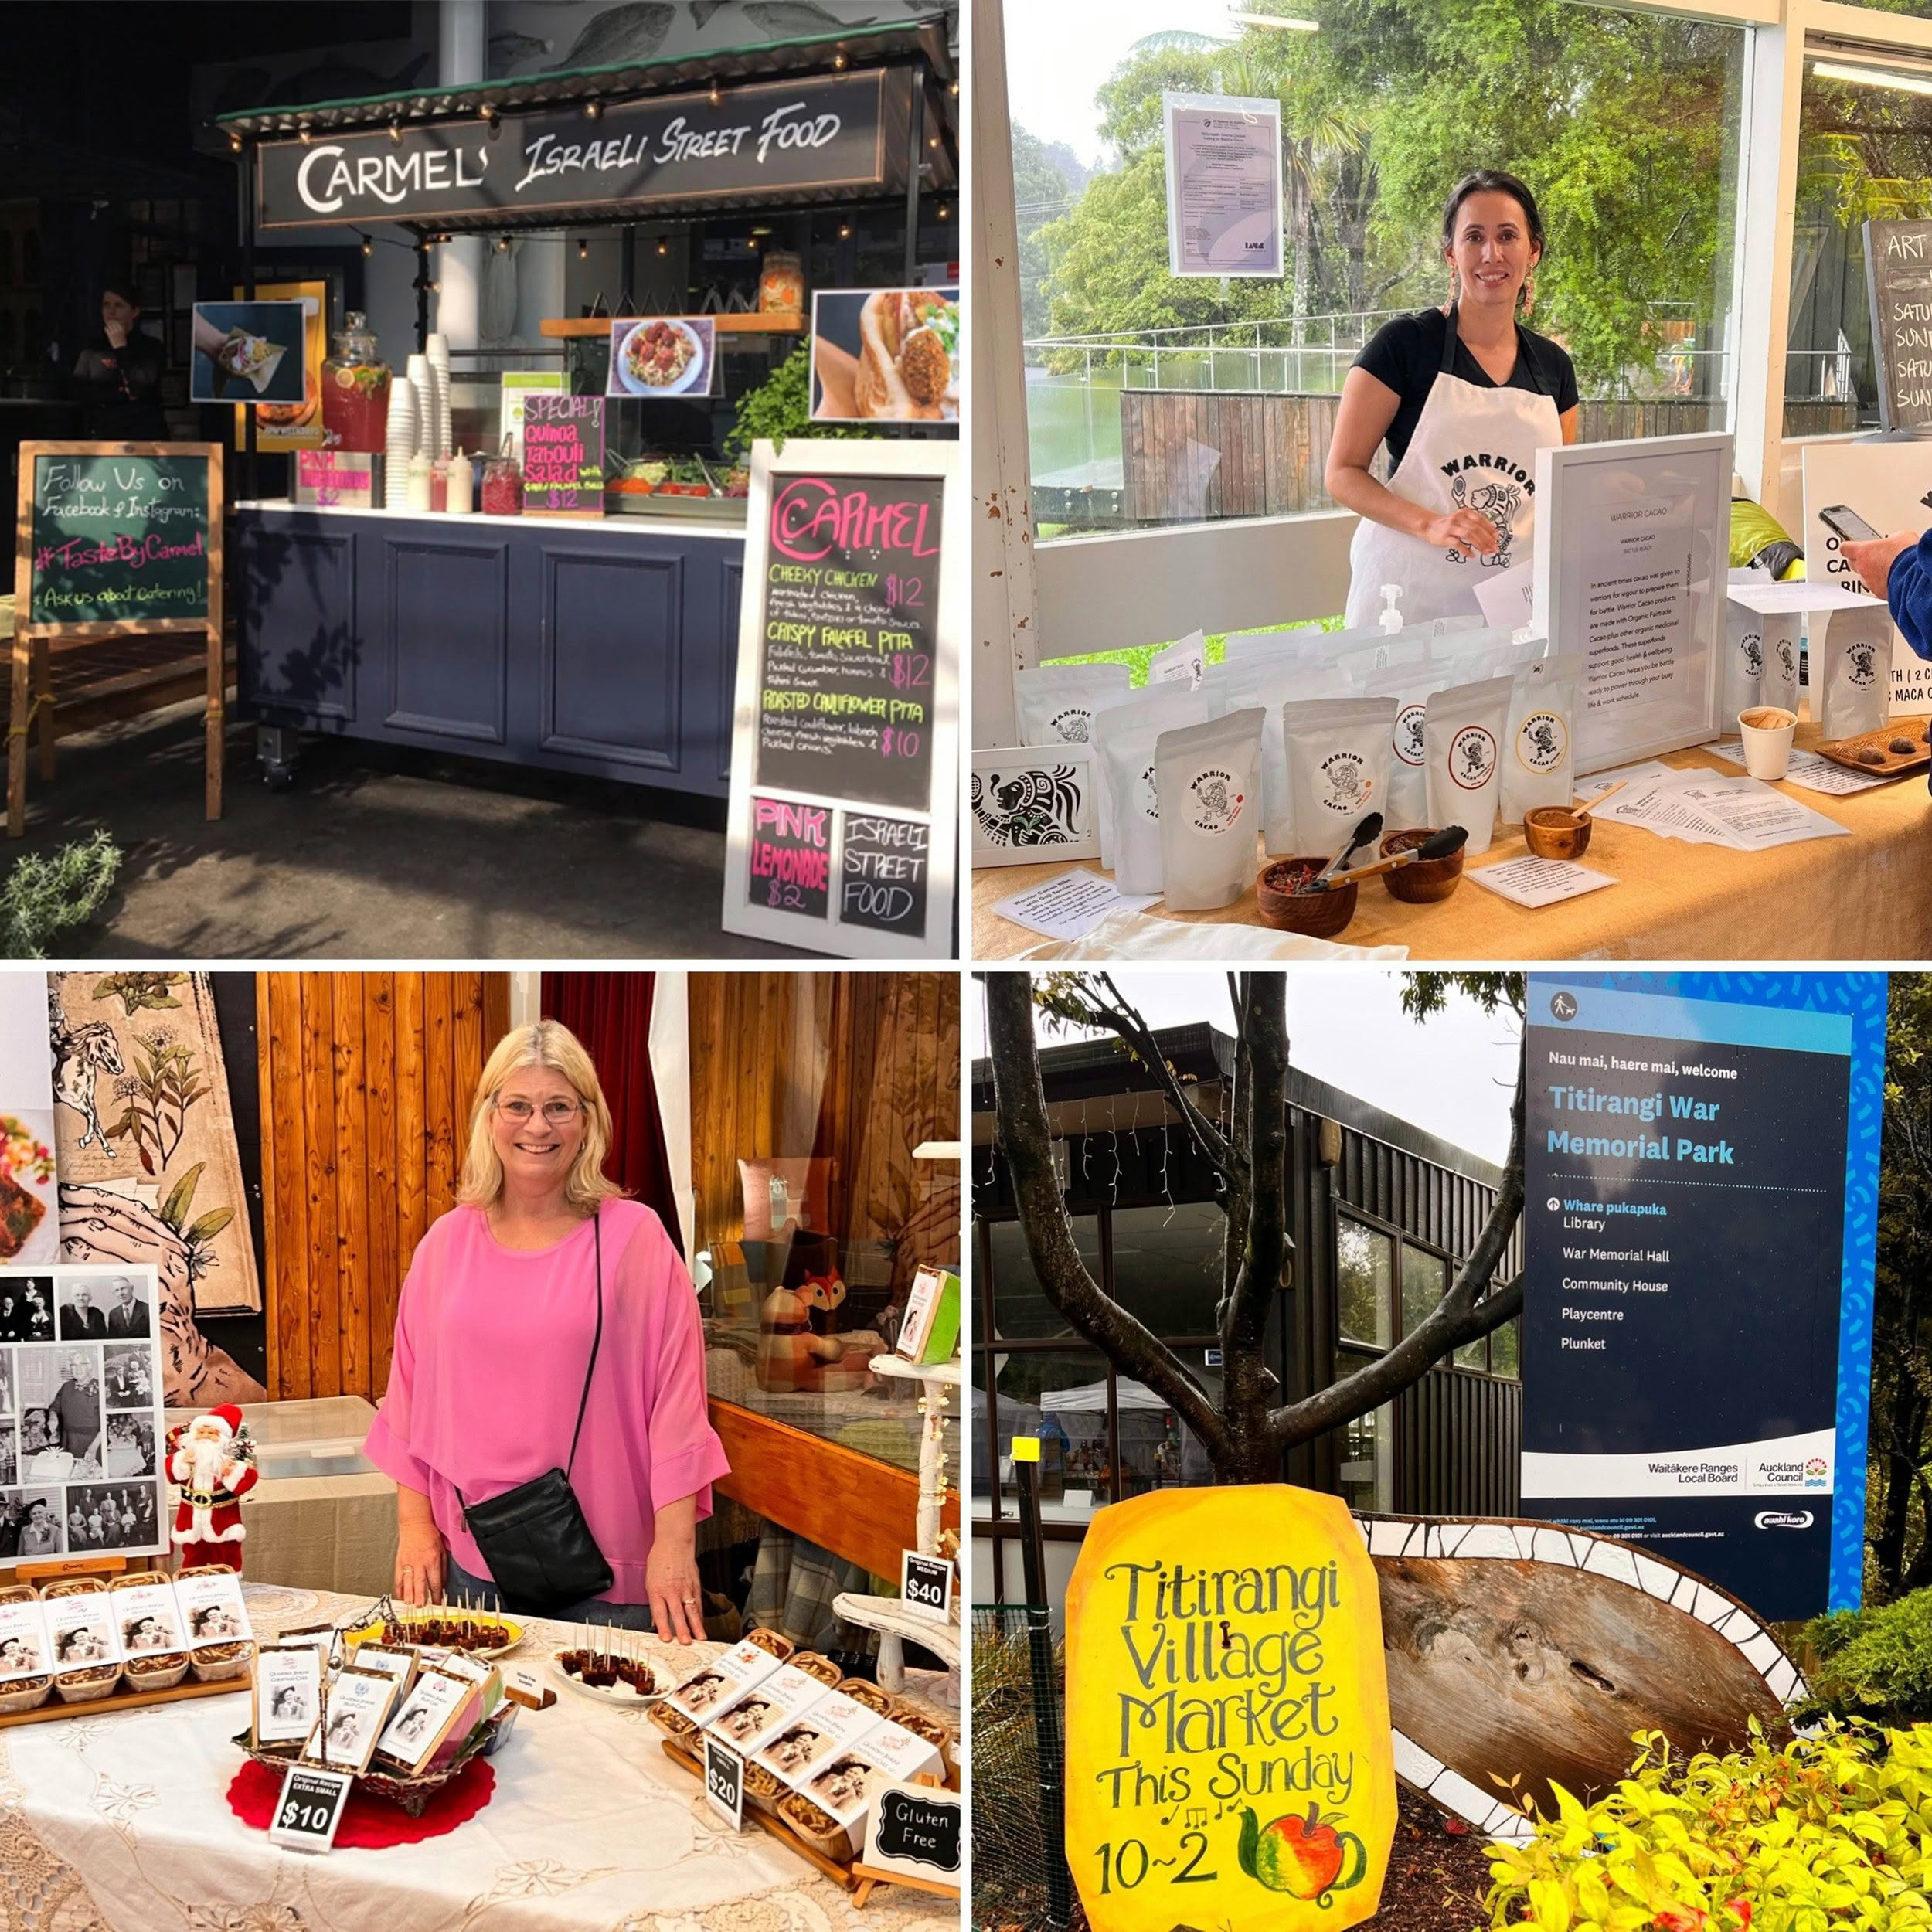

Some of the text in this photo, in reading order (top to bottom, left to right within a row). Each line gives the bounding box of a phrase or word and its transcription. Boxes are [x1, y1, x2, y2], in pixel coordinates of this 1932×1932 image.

[516, 132, 651, 192] ISRAELI
[658, 115, 751, 162] STREET
[755, 103, 842, 162] FOOD
[1888, 235, 1927, 260] ART
[43, 465, 185, 492] Follow Us on
[1440, 454, 1536, 496] WARRIOR
[42, 495, 110, 518] Facebook
[1610, 507, 1668, 521] WARRIOR CACAO
[773, 478, 940, 561] CARMEL
[97, 585, 134, 601] about
[769, 564, 821, 587] CHEEKY
[825, 570, 878, 587] CHICKEN
[886, 573, 925, 607] $12
[767, 622, 816, 648] CRISPY
[821, 626, 872, 649] FALAFEL
[1846, 643, 1876, 655] WARRIOR
[889, 655, 930, 689] $12
[763, 690, 810, 712] ROASTED
[1896, 687, 1923, 702] MACA
[1523, 716, 1555, 733] WARRIOR
[882, 726, 919, 758] $10
[1458, 733, 1486, 747] WARRIOR
[1321, 753, 1363, 770] WARRIOR
[1190, 770, 1230, 790] WARRIOR
[1323, 799, 1347, 810] CACAO
[755, 798, 826, 847] PINK
[1194, 820, 1218, 830] CACAO
[846, 818, 927, 852] ISRAELI
[753, 839, 828, 891] LEMONADE
[845, 849, 924, 882] STREET
[767, 879, 806, 909] $2
[844, 882, 913, 920] FOOD
[1549, 1051, 1738, 1080] Nau mai, haere mai, welcome
[1549, 1085, 1720, 1123] Titirangi War
[1547, 1131, 1734, 1164] Memorial Park
[1564, 1199, 1667, 1217] Whare pukapuka
[1563, 1216, 1606, 1232] Library
[1563, 1247, 1670, 1263] War Memorial Hall
[1562, 1278, 1668, 1294] Community House
[1562, 1308, 1624, 1323] Playcentre
[1561, 1338, 1606, 1350] Plunket
[1679, 1473, 1738, 1483] Local Board
[1700, 1463, 1738, 1475] Ranges
[1759, 1462, 1804, 1472] Auckland
[1767, 1472, 1803, 1482] Council
[1787, 1515, 1805, 1524] kore
[908, 1578, 941, 1604] $40
[1104, 1560, 1340, 1631] Titirangi
[1121, 1621, 1324, 1698] Village
[1118, 1682, 1338, 1758] Market
[294, 1775, 341, 1788] Original Recipe
[710, 1768, 735, 1804] $20
[1096, 1746, 1355, 1808] This Sunday
[293, 1783, 336, 1796] EXTRA SMALL
[282, 1800, 328, 1829] $10
[896, 1803, 948, 1828] Gluten
[903, 1827, 936, 1848] Free
